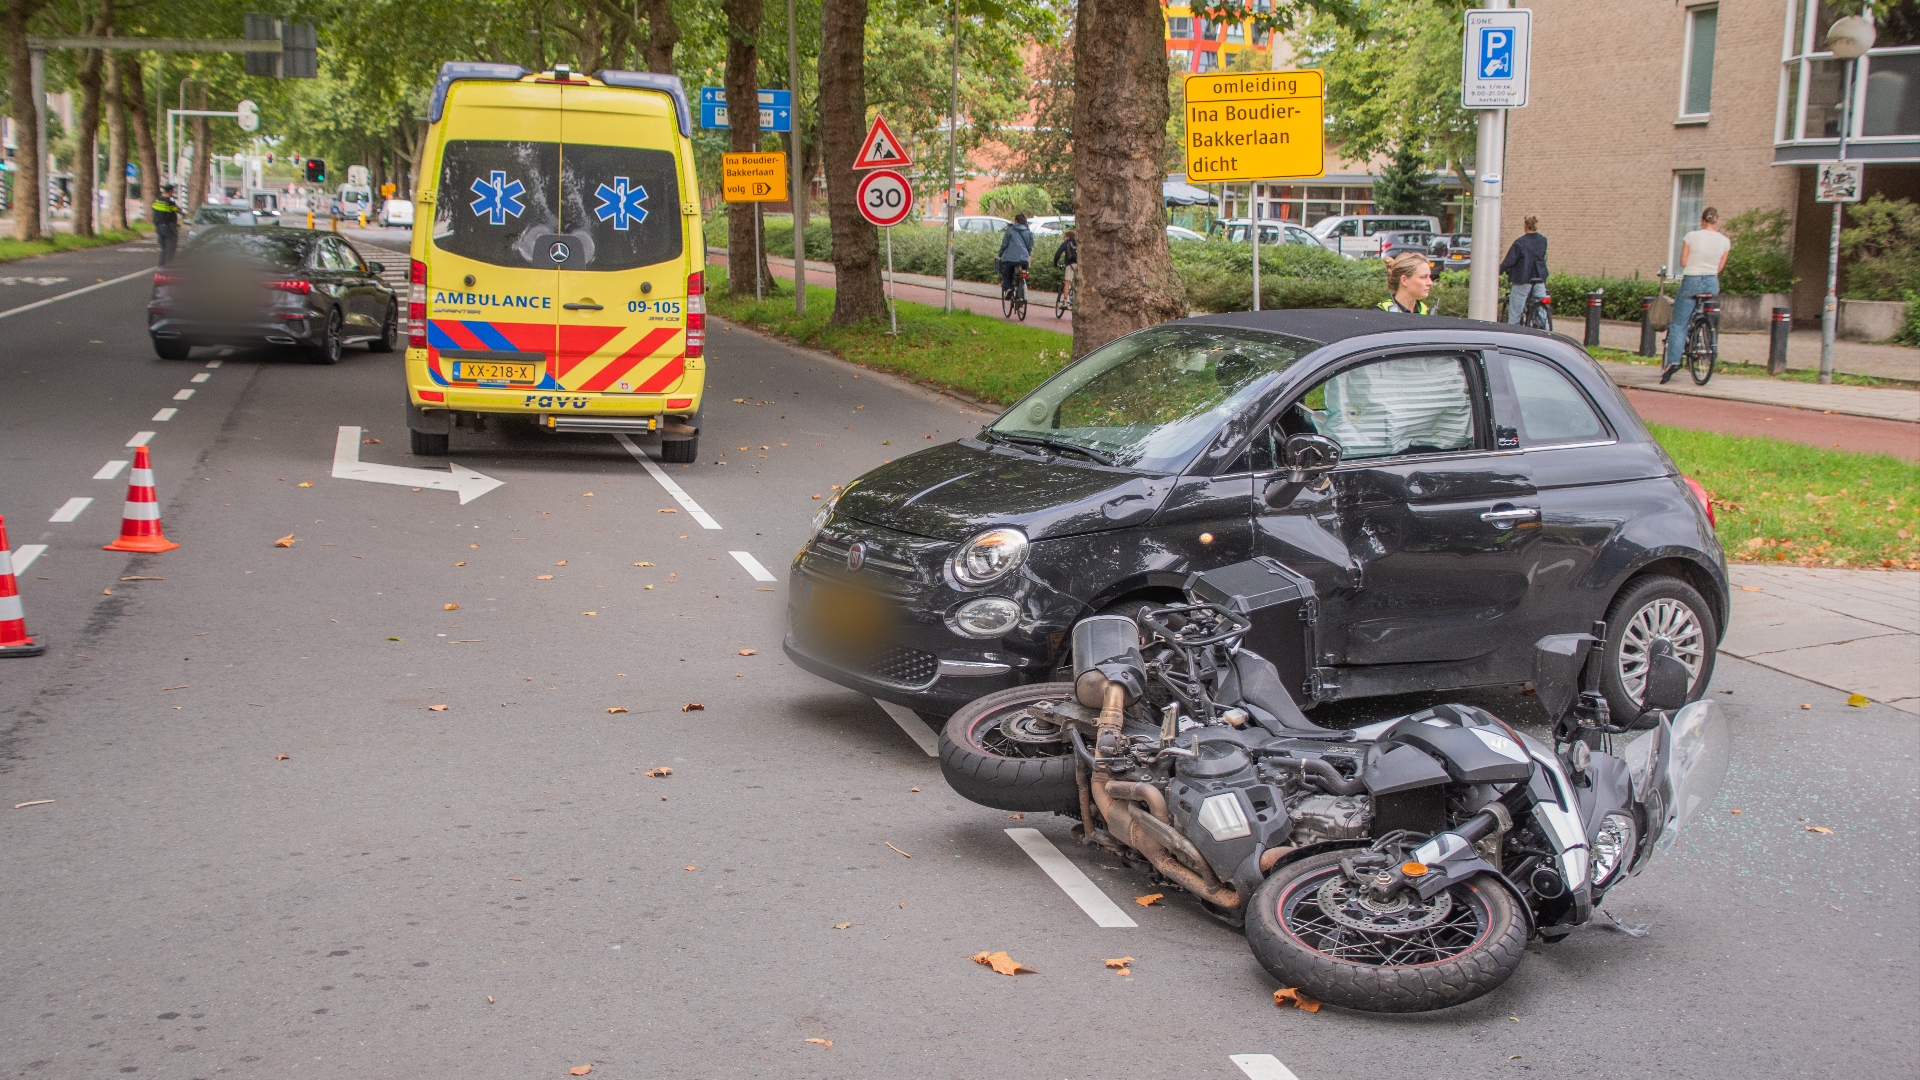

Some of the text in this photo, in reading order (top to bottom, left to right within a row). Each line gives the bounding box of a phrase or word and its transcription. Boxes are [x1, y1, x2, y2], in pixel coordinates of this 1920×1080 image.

[1487, 32, 1507, 58] P
[1213, 77, 1297, 95] omleiding
[1192, 103, 1301, 122] Ina Boudier-
[1192, 130, 1290, 148] Bakkerlaan
[726, 156, 779, 165] Ina Boudier-
[1193, 156, 1238, 173] dicht
[726, 168, 774, 177] Bakkerlaan
[727, 184, 763, 195] volg B
[869, 188, 902, 208] 30
[434, 292, 551, 309] AMBULANCE
[627, 300, 681, 314] 09-105
[467, 364, 528, 379] XX-218-X
[524, 395, 588, 409] ravu
